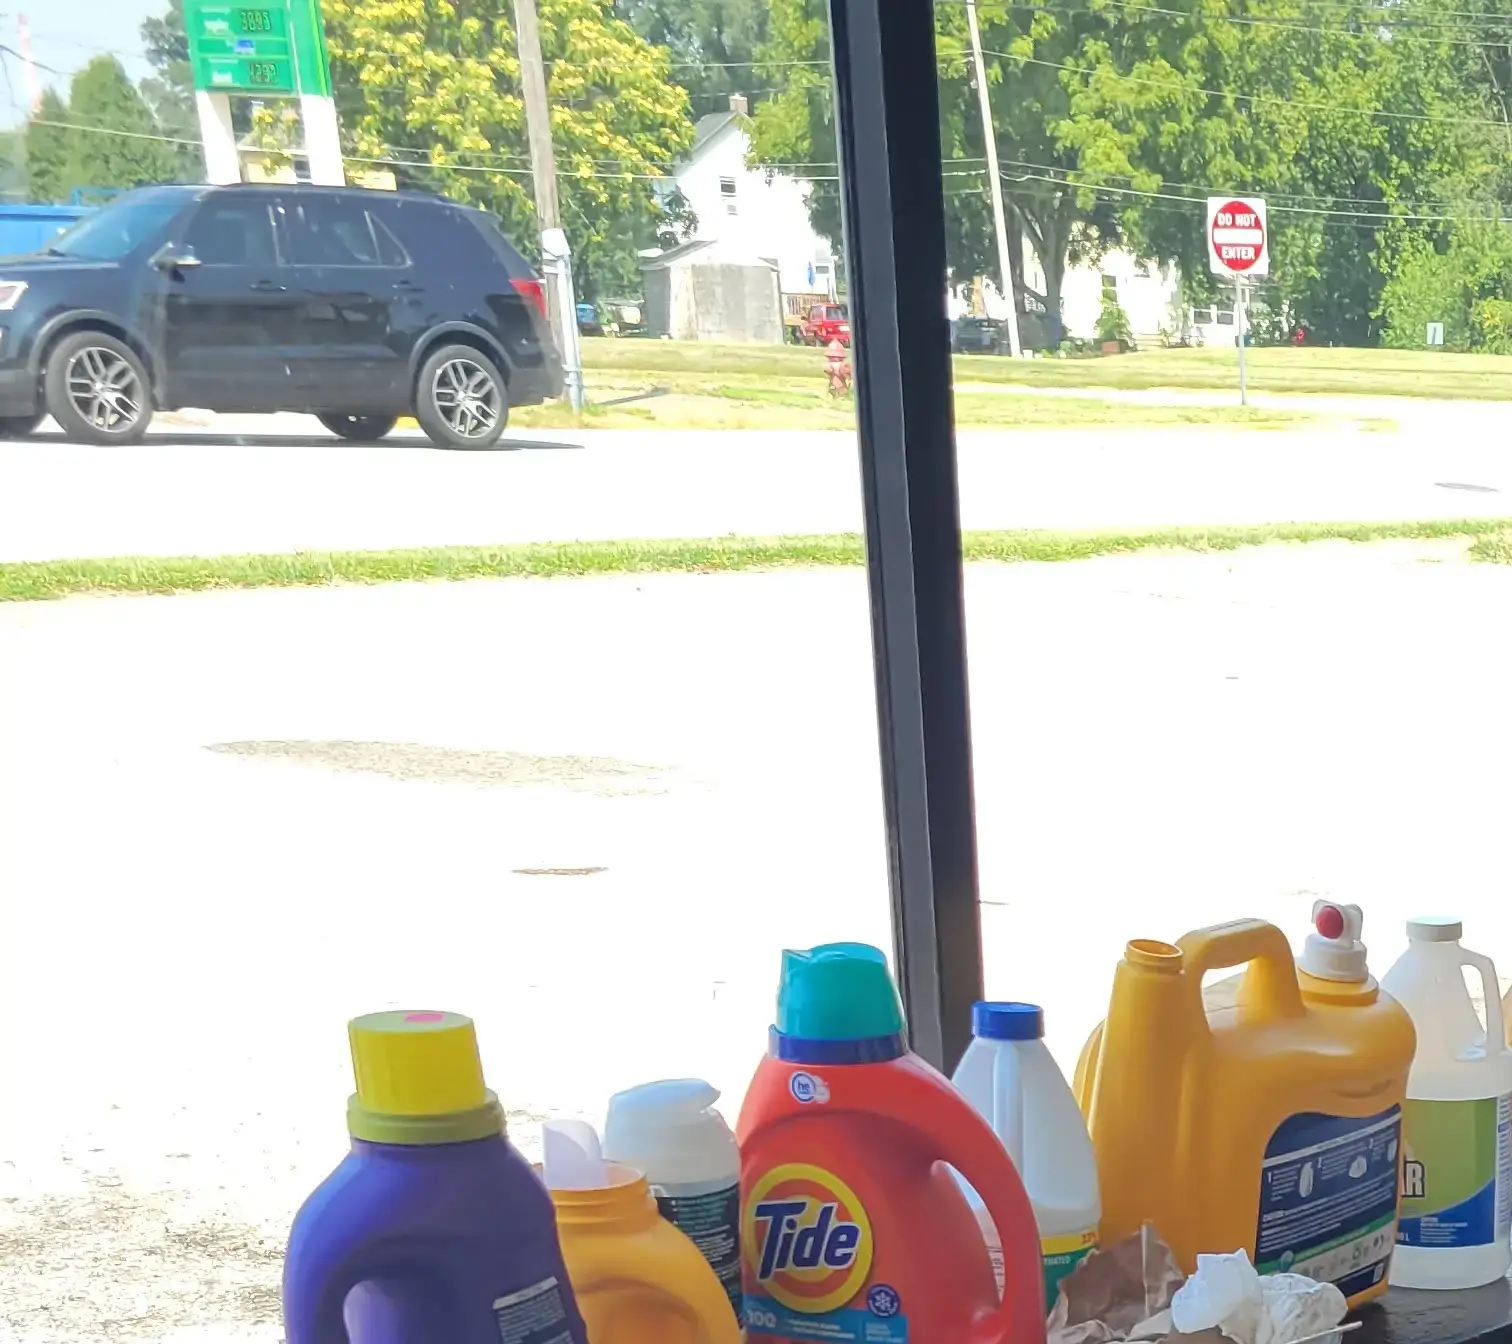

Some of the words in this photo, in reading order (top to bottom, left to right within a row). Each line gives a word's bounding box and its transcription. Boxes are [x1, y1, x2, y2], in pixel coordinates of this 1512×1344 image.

[1218, 212, 1233, 227] DO
[1235, 213, 1257, 227] NOT
[1221, 246, 1256, 260] ENTER
[754, 1200, 861, 1281] Tide
